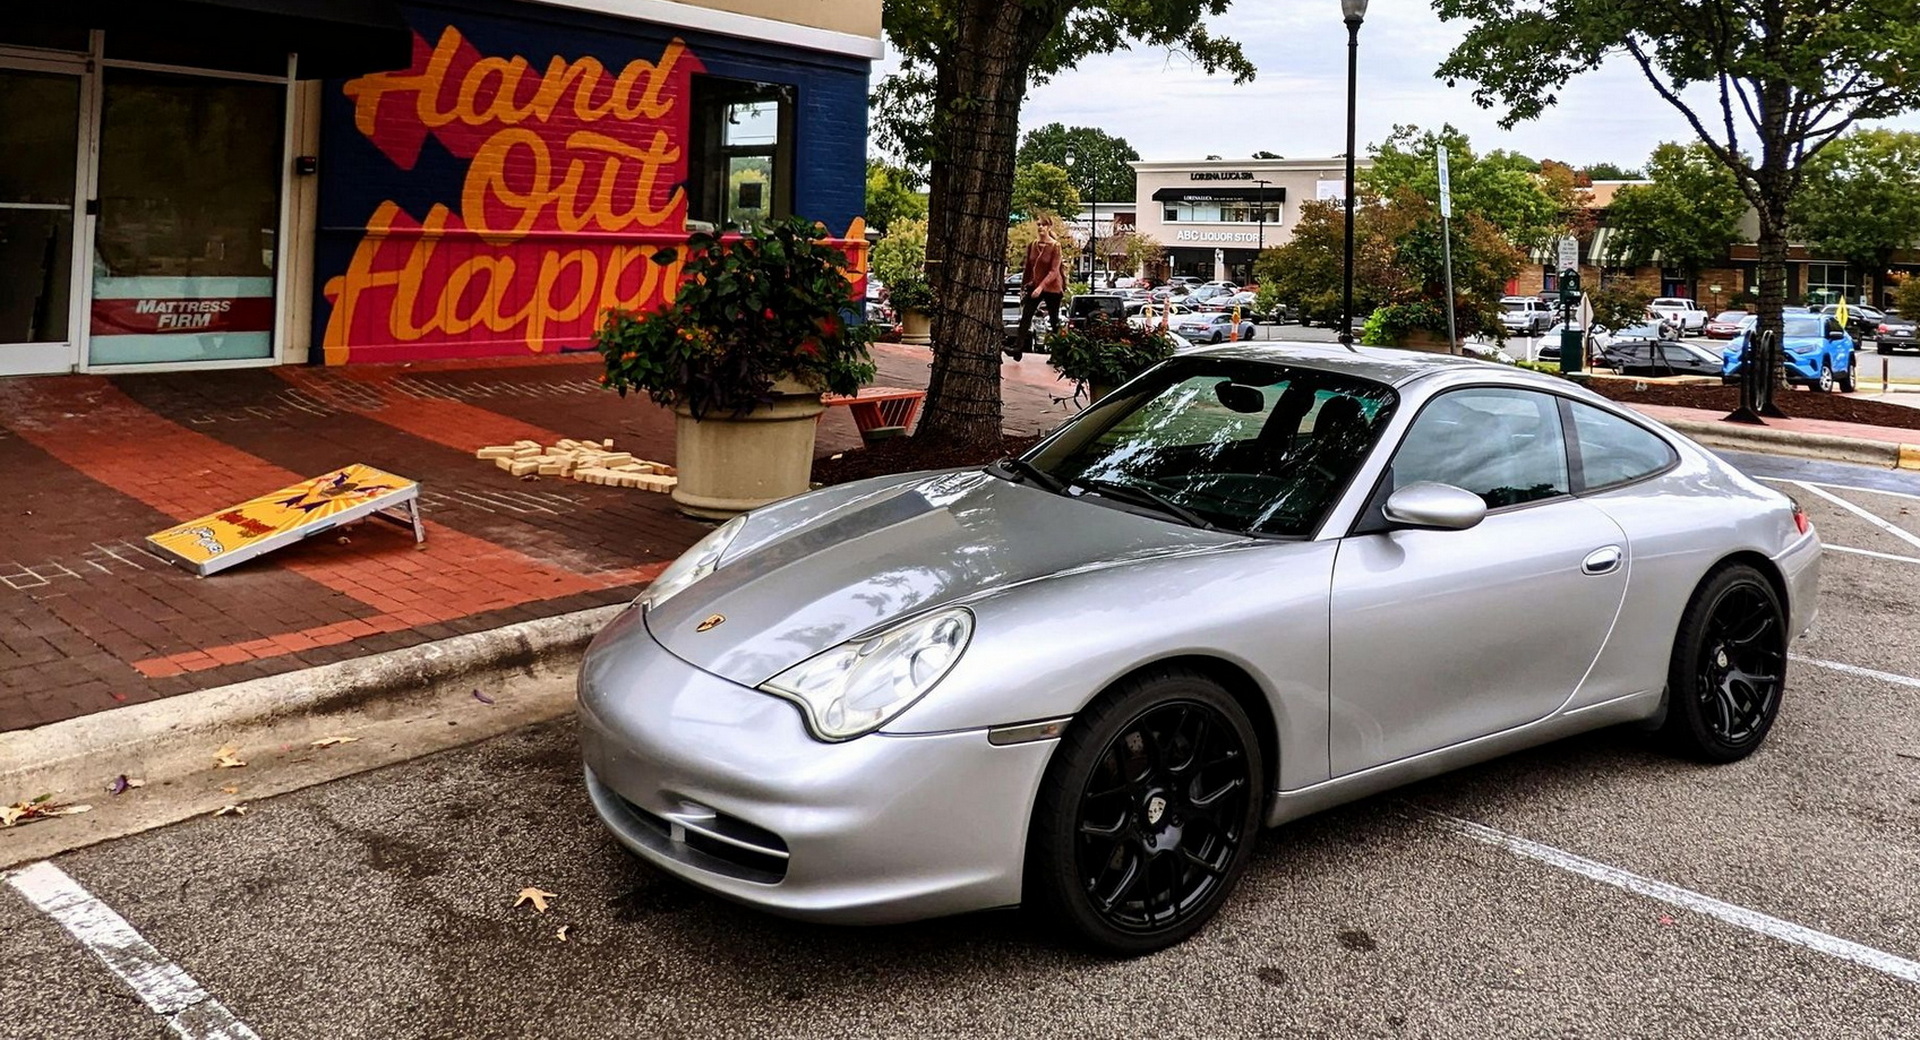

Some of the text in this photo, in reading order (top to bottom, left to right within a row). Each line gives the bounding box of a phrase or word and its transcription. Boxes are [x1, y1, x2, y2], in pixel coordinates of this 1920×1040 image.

[343, 25, 685, 137] Hand
[461, 128, 688, 246] Out
[1190, 172, 1220, 181] LORENA
[1221, 172, 1240, 181] LUCA
[1177, 229, 1199, 241] ABC
[1200, 231, 1233, 242] LIQUOR
[324, 200, 705, 366] Happ
[158, 313, 211, 328] FIRM
